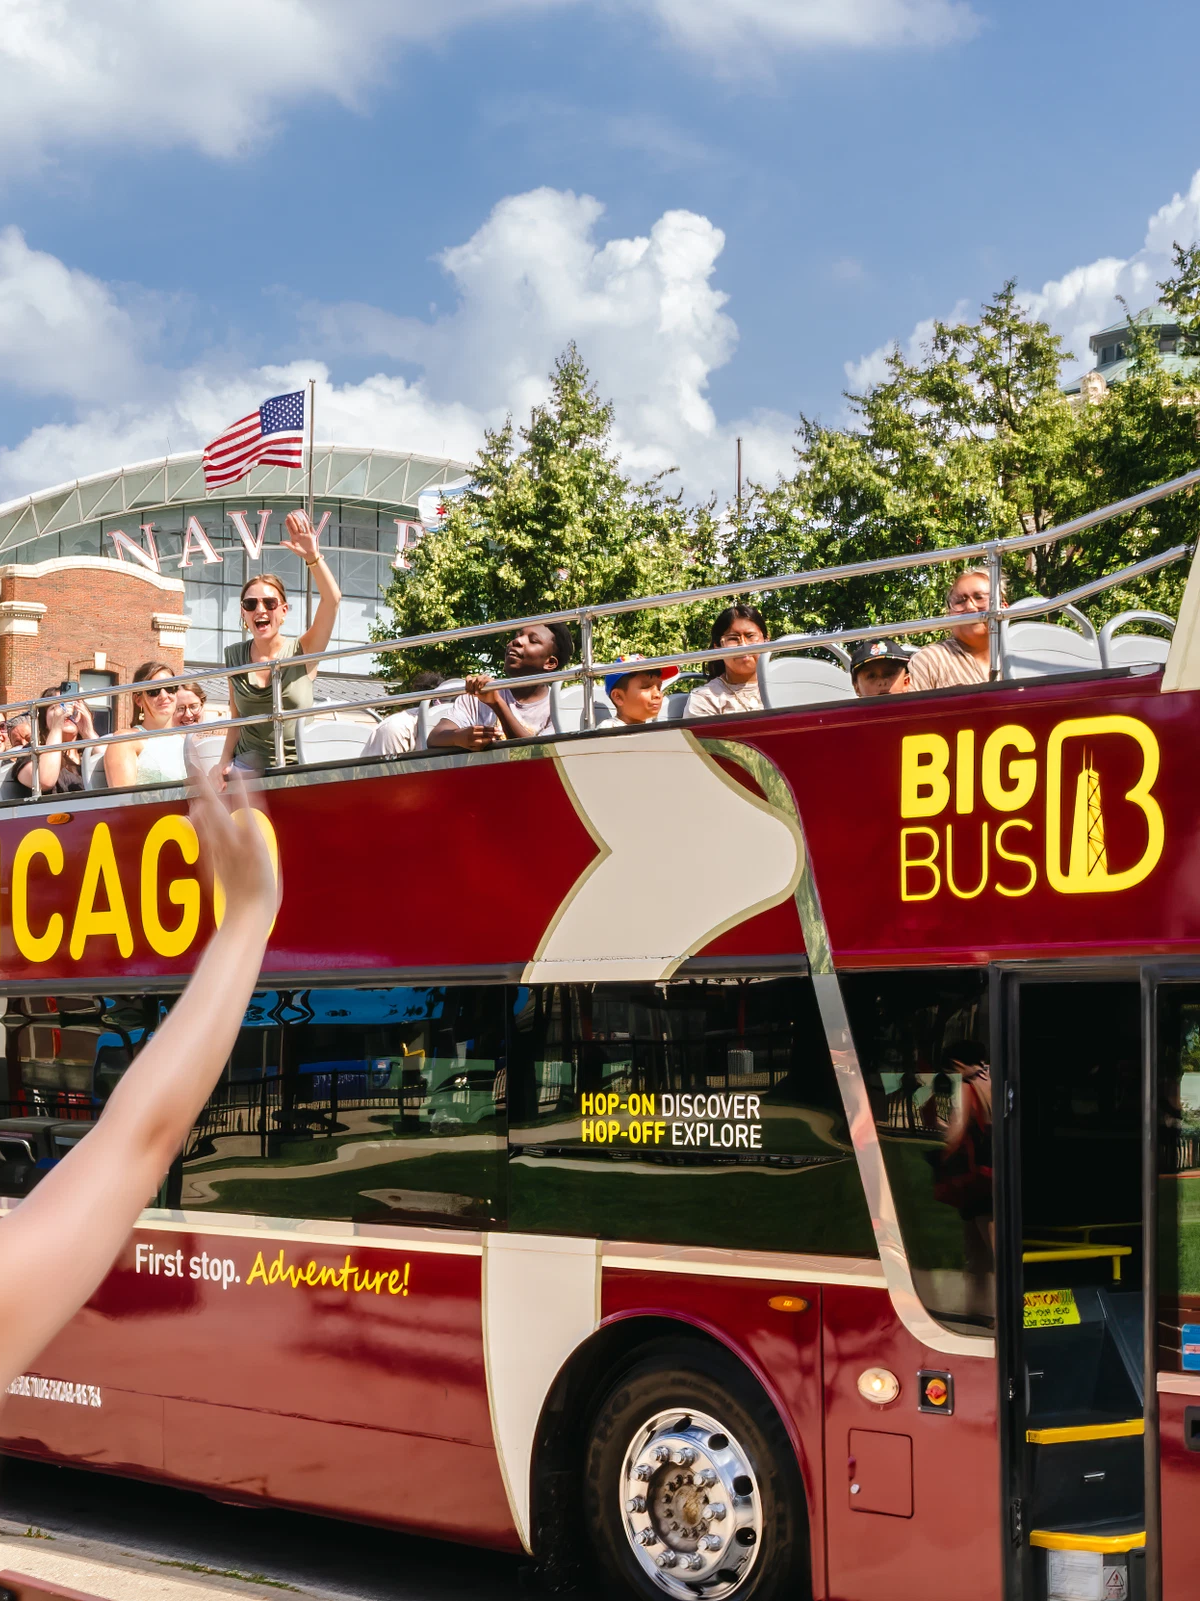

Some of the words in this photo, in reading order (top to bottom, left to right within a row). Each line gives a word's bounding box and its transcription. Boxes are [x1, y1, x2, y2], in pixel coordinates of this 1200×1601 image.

[901, 724, 1037, 819] BIG
[901, 818, 1037, 901] BUS
[581, 1092, 655, 1116] HOP-ON
[661, 1093, 760, 1119] DISCOVER
[581, 1119, 666, 1144] HOP-OFF
[671, 1121, 763, 1149] EXPLORE
[135, 1243, 184, 1278] First
[189, 1251, 241, 1290] stop.
[246, 1249, 410, 1297] Adventure!
